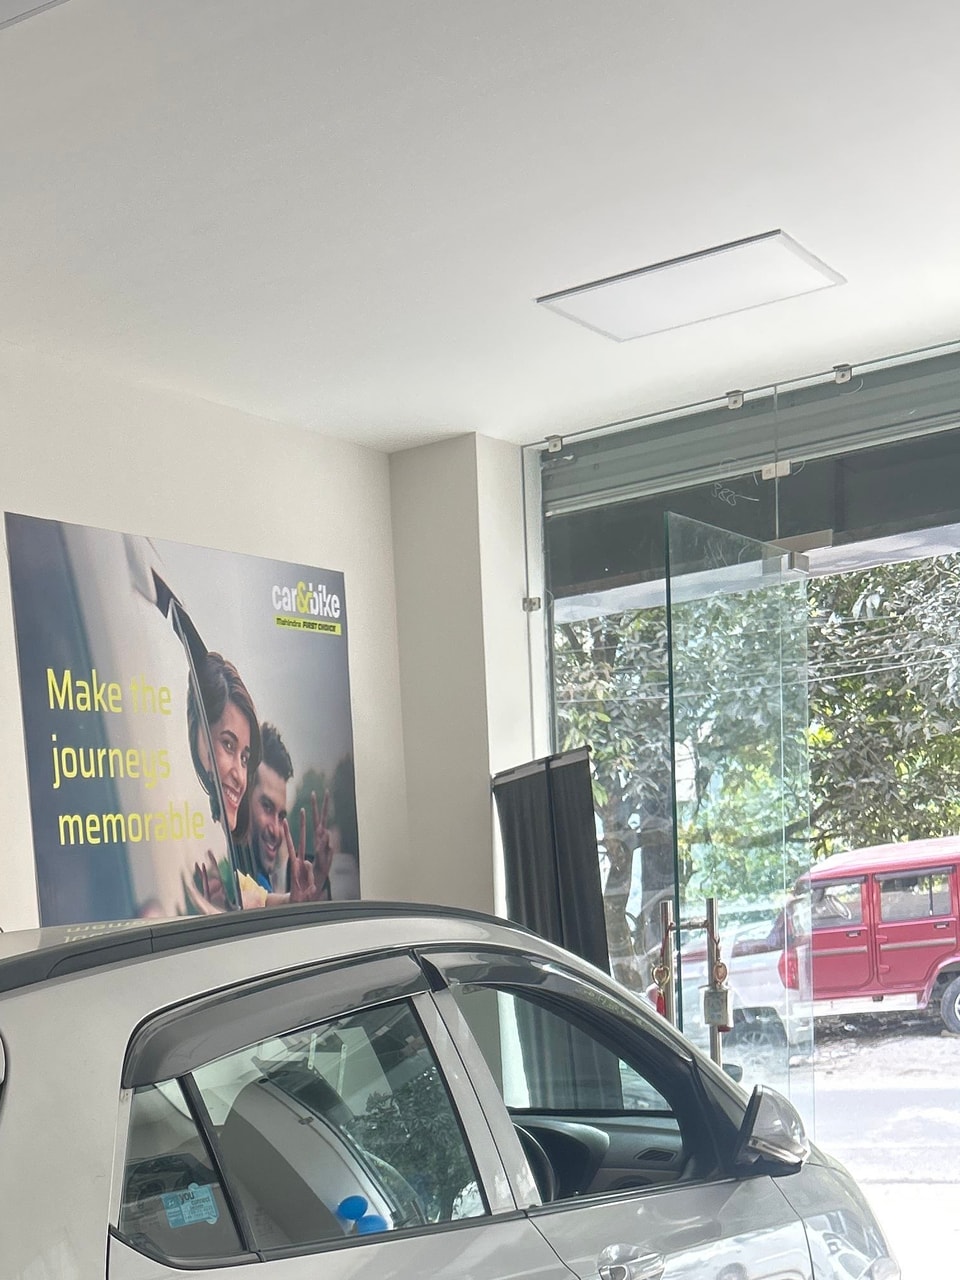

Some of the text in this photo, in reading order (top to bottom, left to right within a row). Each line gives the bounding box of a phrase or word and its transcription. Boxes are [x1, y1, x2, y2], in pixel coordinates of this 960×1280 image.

[46, 668, 171, 716] Make the
[51, 733, 171, 790] journeys
[57, 801, 205, 846] memorable
